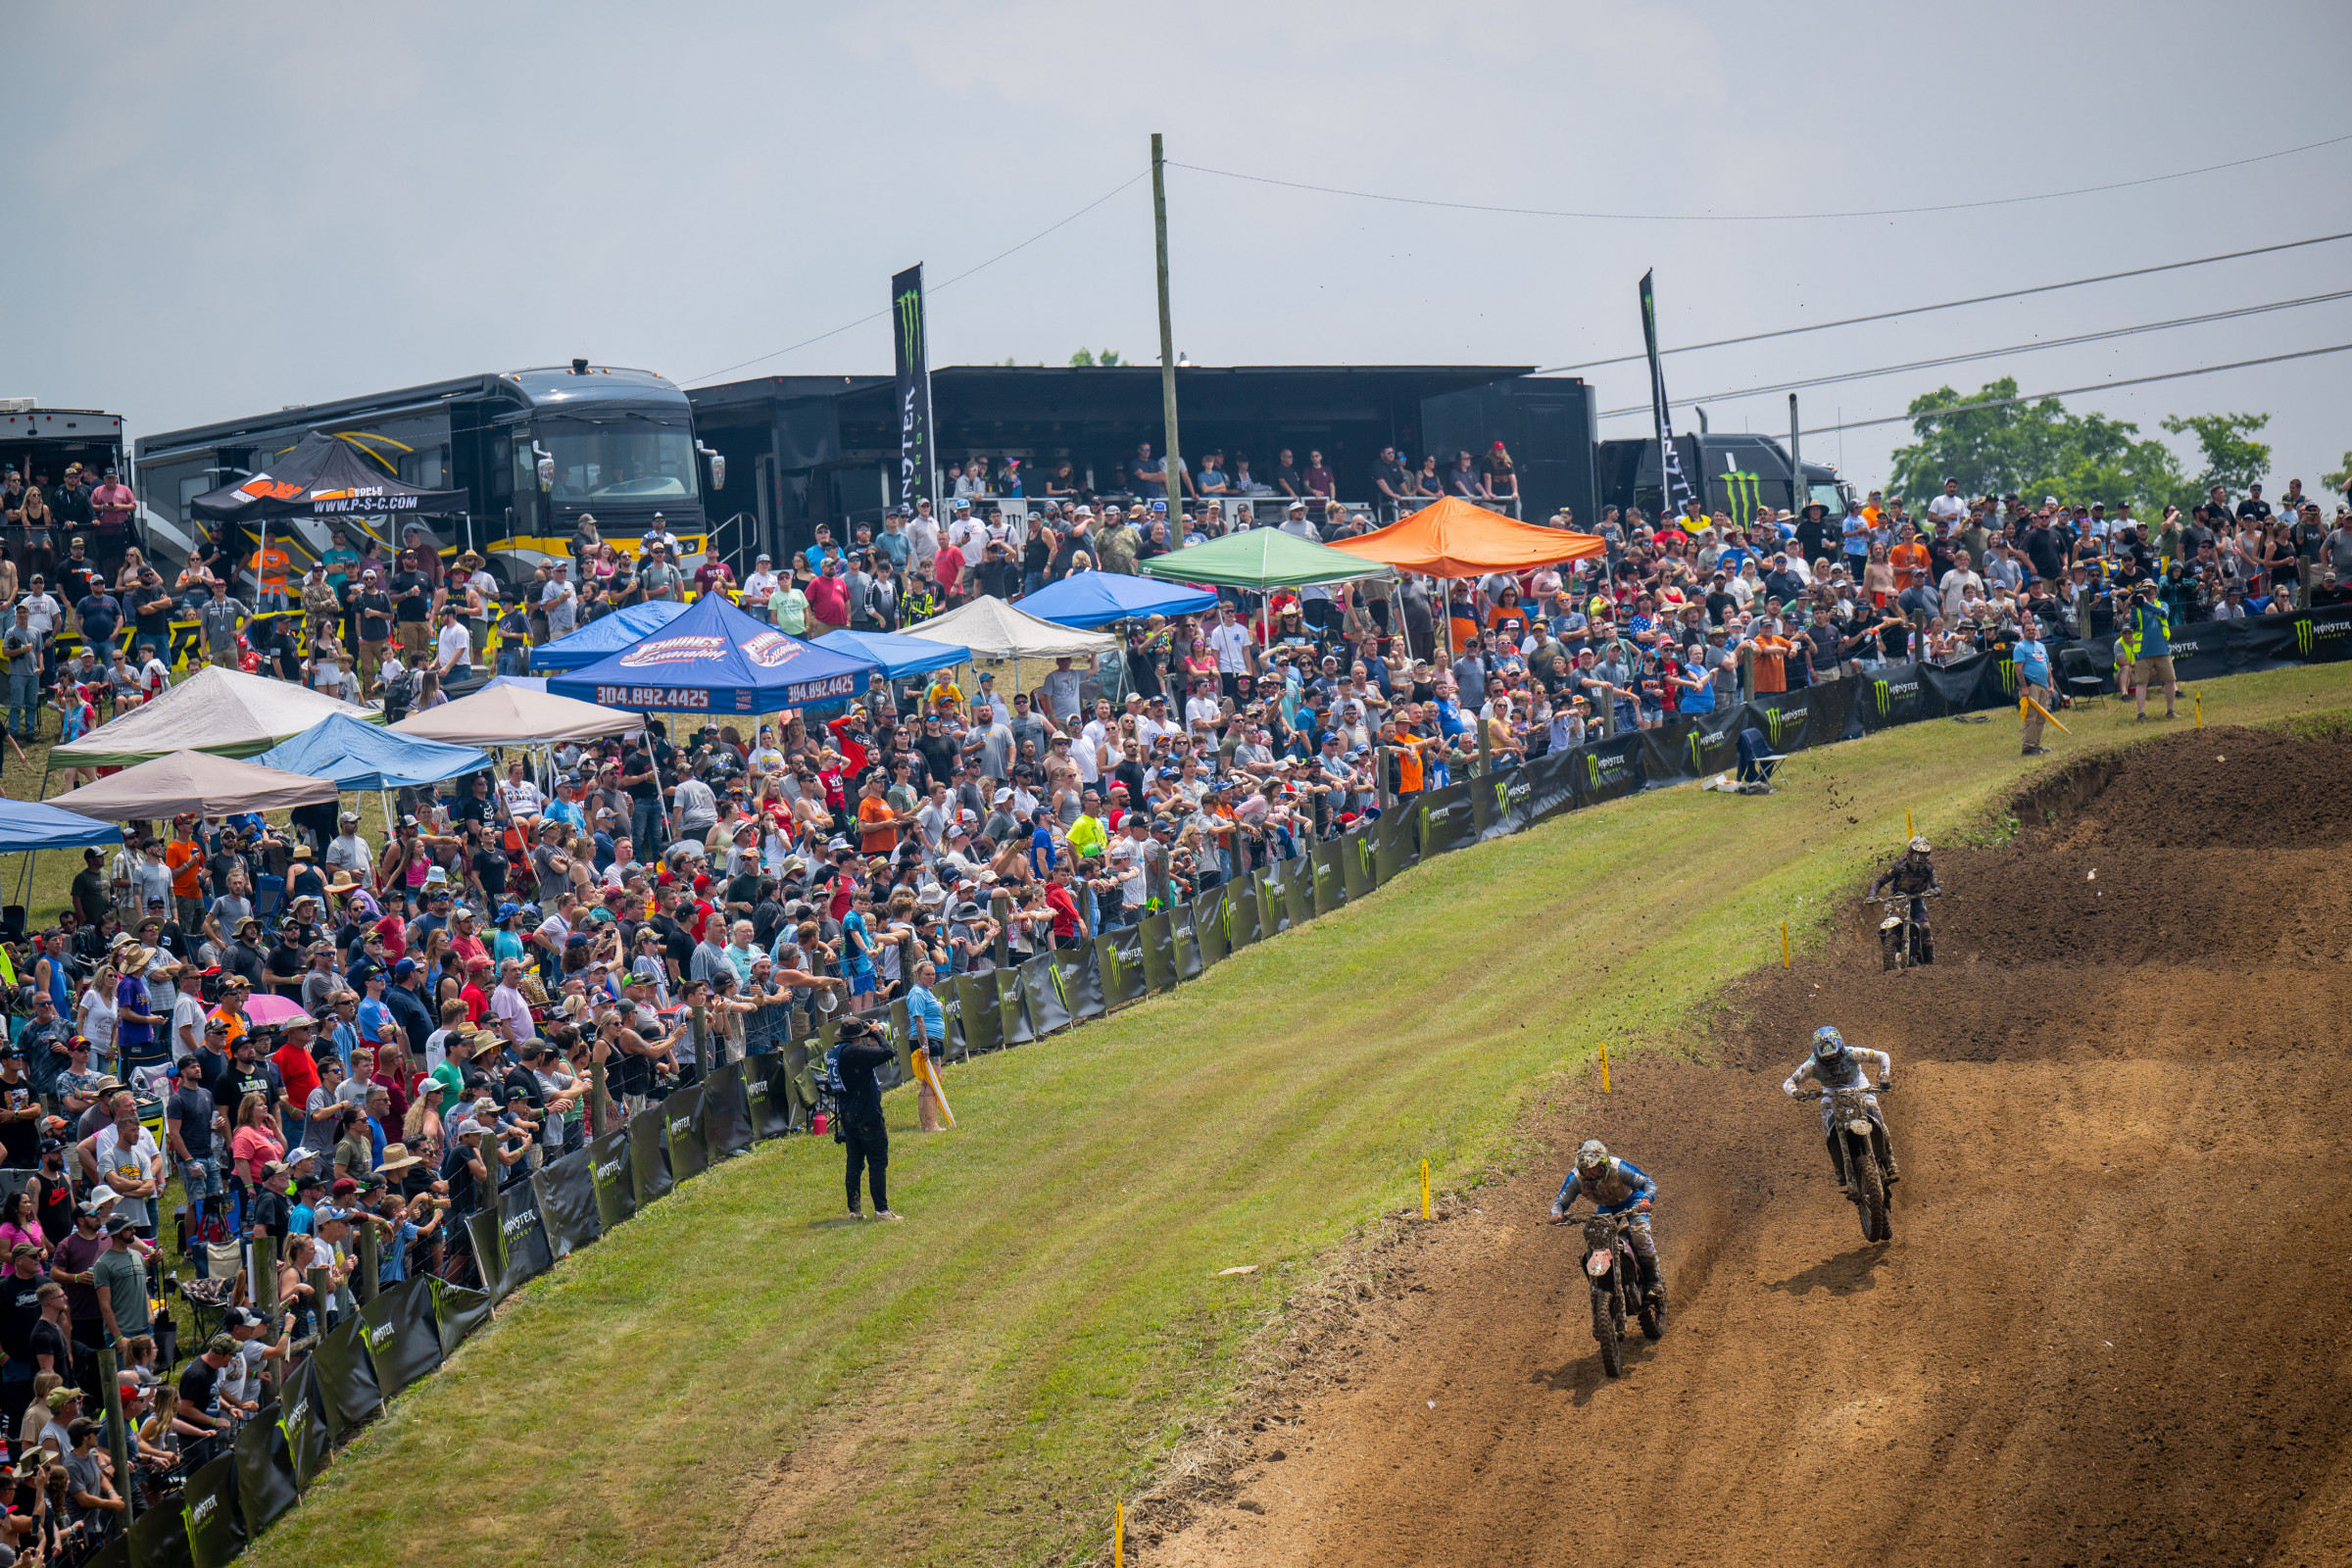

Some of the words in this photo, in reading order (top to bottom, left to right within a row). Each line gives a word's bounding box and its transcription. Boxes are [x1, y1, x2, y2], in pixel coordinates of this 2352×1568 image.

[314, 496, 417, 513] WWW.P-S-C.COM
[707, 568, 725, 577] BEER
[2313, 621, 2351, 634] MONSTER
[621, 635, 725, 662] JENNINGS
[2168, 641, 2198, 655] ONSTER
[788, 673, 854, 705] 304.892.4425
[1889, 681, 1919, 695] MONSTER
[596, 686, 710, 708] 304.892.4425
[1781, 708, 1808, 722] MONSTER
[1597, 755, 1625, 769] MONSTER
[237, 1079, 268, 1093] LEAD
[52, 1187, 66, 1198] NIKE
[502, 1208, 536, 1237] MONSTER
[510, 1227, 532, 1244] ENERGY
[370, 1321, 395, 1347] MONSTER
[193, 1494, 218, 1525] MONSTER
